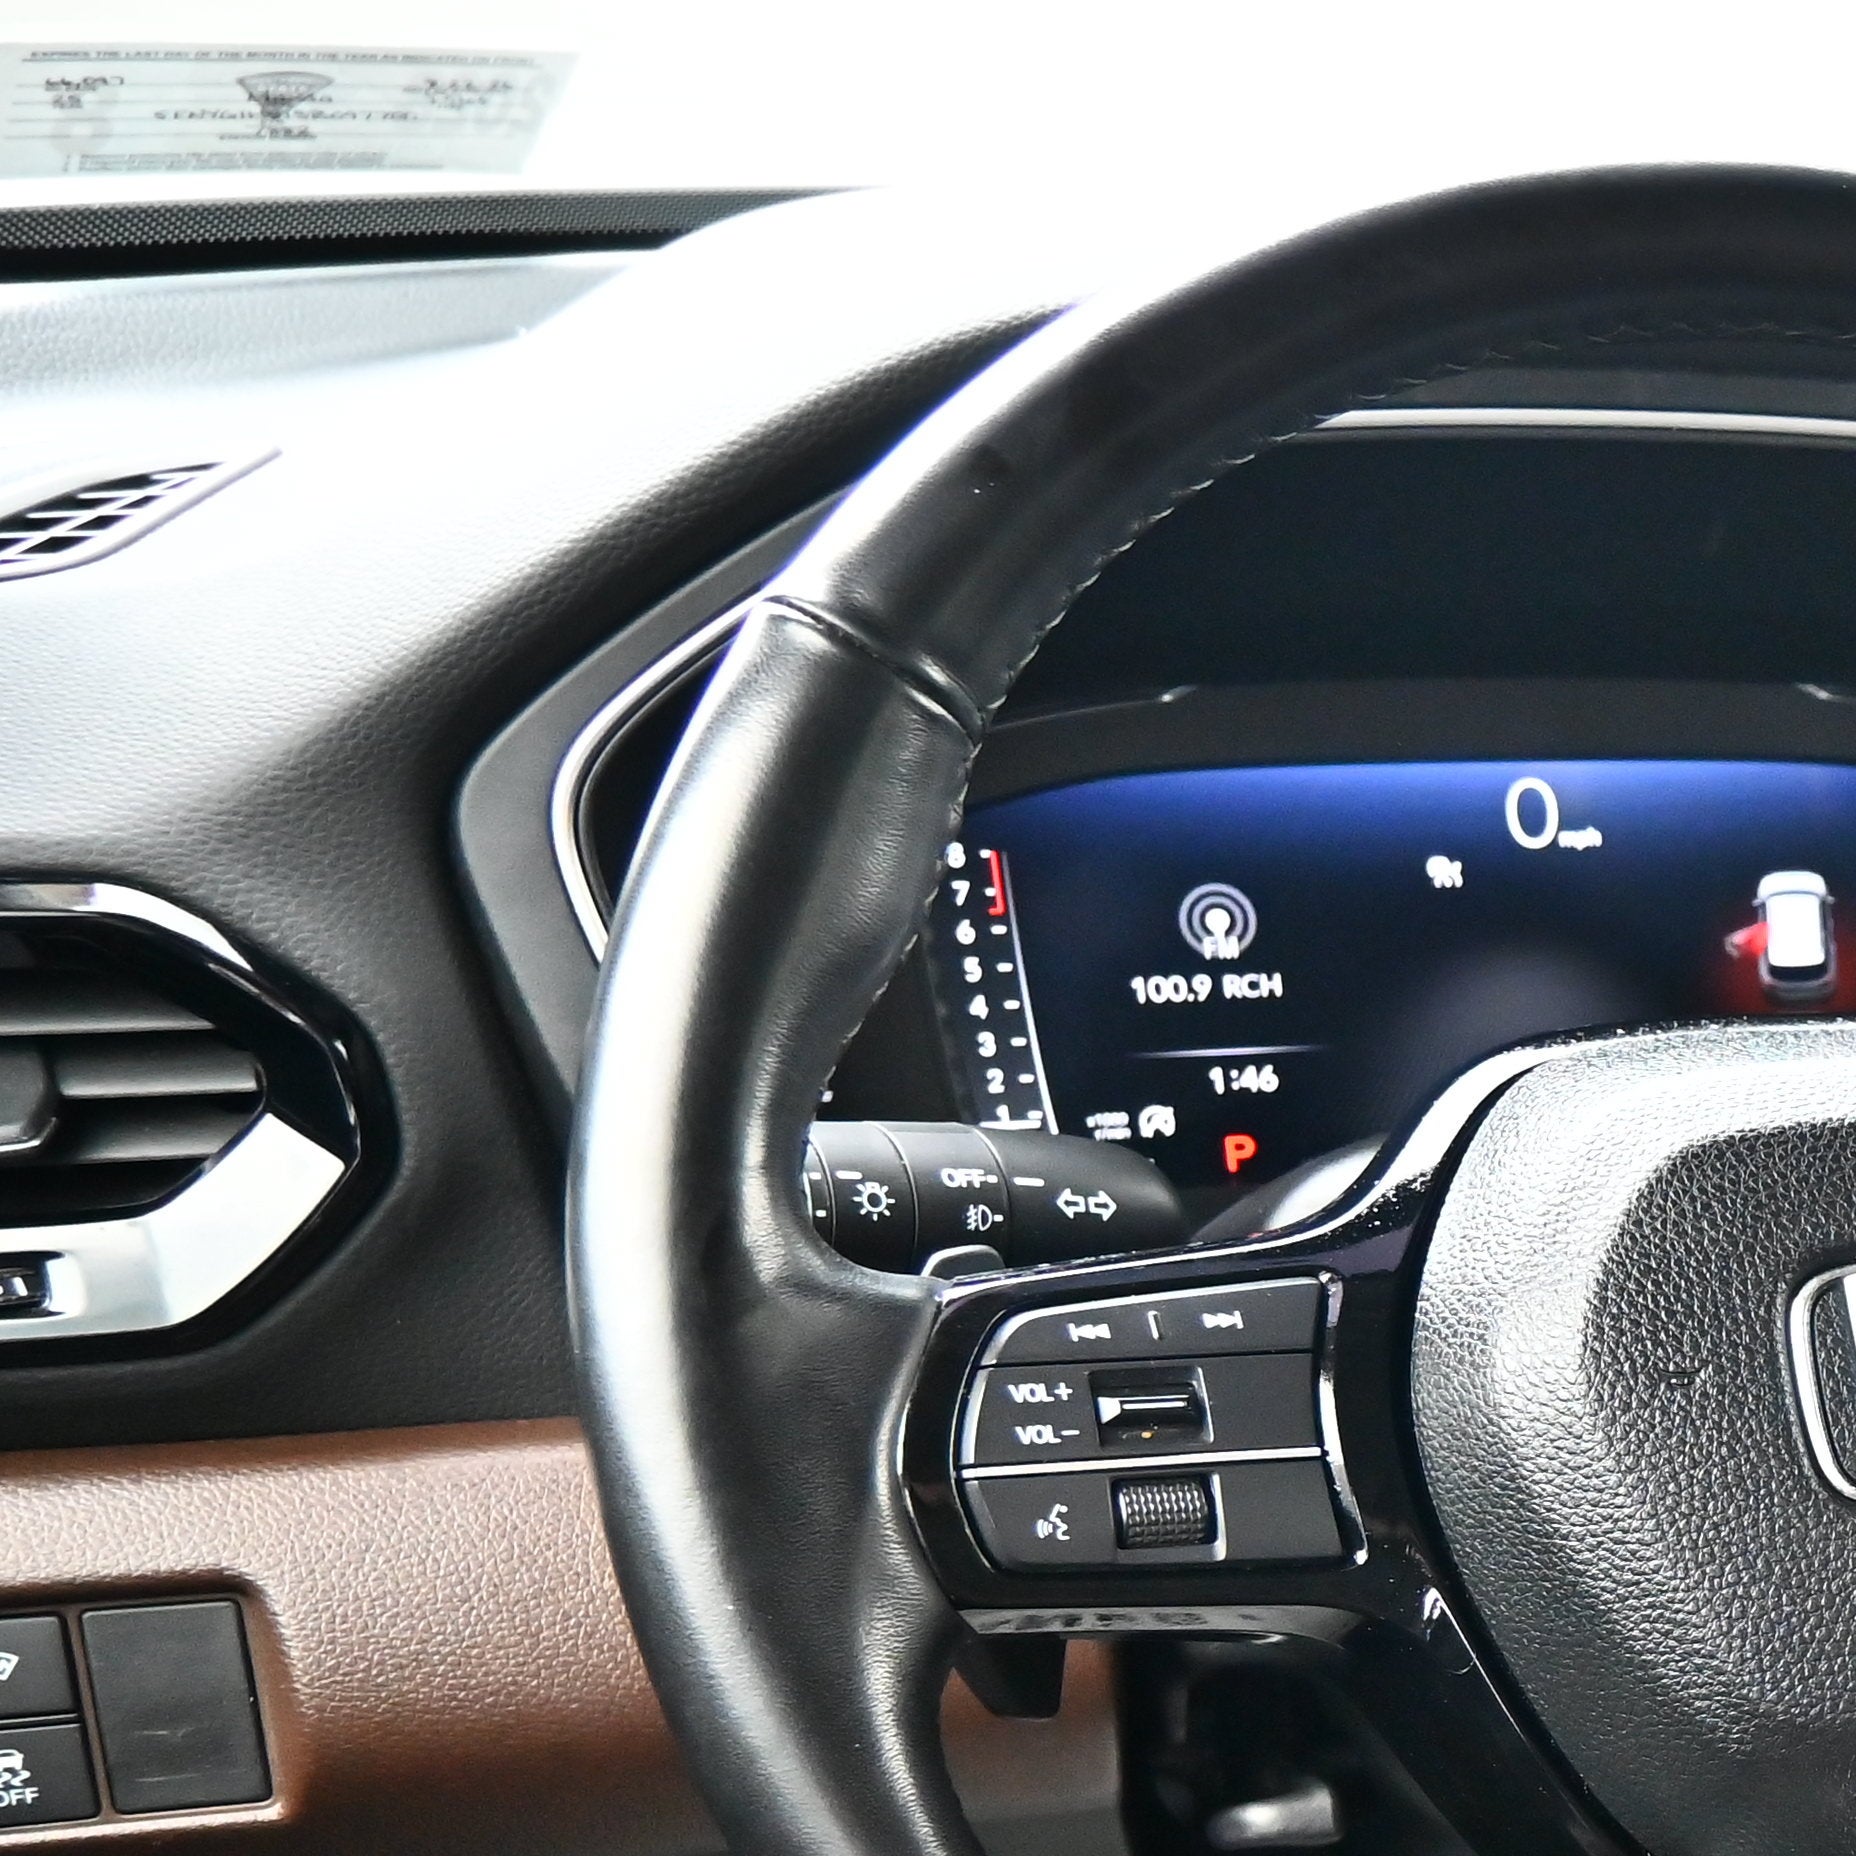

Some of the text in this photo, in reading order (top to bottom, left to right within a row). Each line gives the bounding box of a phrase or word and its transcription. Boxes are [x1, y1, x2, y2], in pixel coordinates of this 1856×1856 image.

[1504, 775, 1604, 851] 0 mph
[945, 841, 967, 869] 8
[949, 879, 971, 907] 7
[954, 918, 977, 945] 6
[1202, 934, 1241, 961] FM
[962, 955, 984, 984] 5
[1130, 972, 1285, 1005] 100.9 RCH
[968, 993, 990, 1020] 4
[975, 1030, 998, 1058] 3
[984, 1066, 1006, 1095] 2
[1207, 1063, 1281, 1096] 1:46
[1222, 1132, 1259, 1175] P
[940, 1167, 986, 1189] OFF
[1006, 1381, 1074, 1405] VOL+
[1014, 1424, 1081, 1446] VOL-
